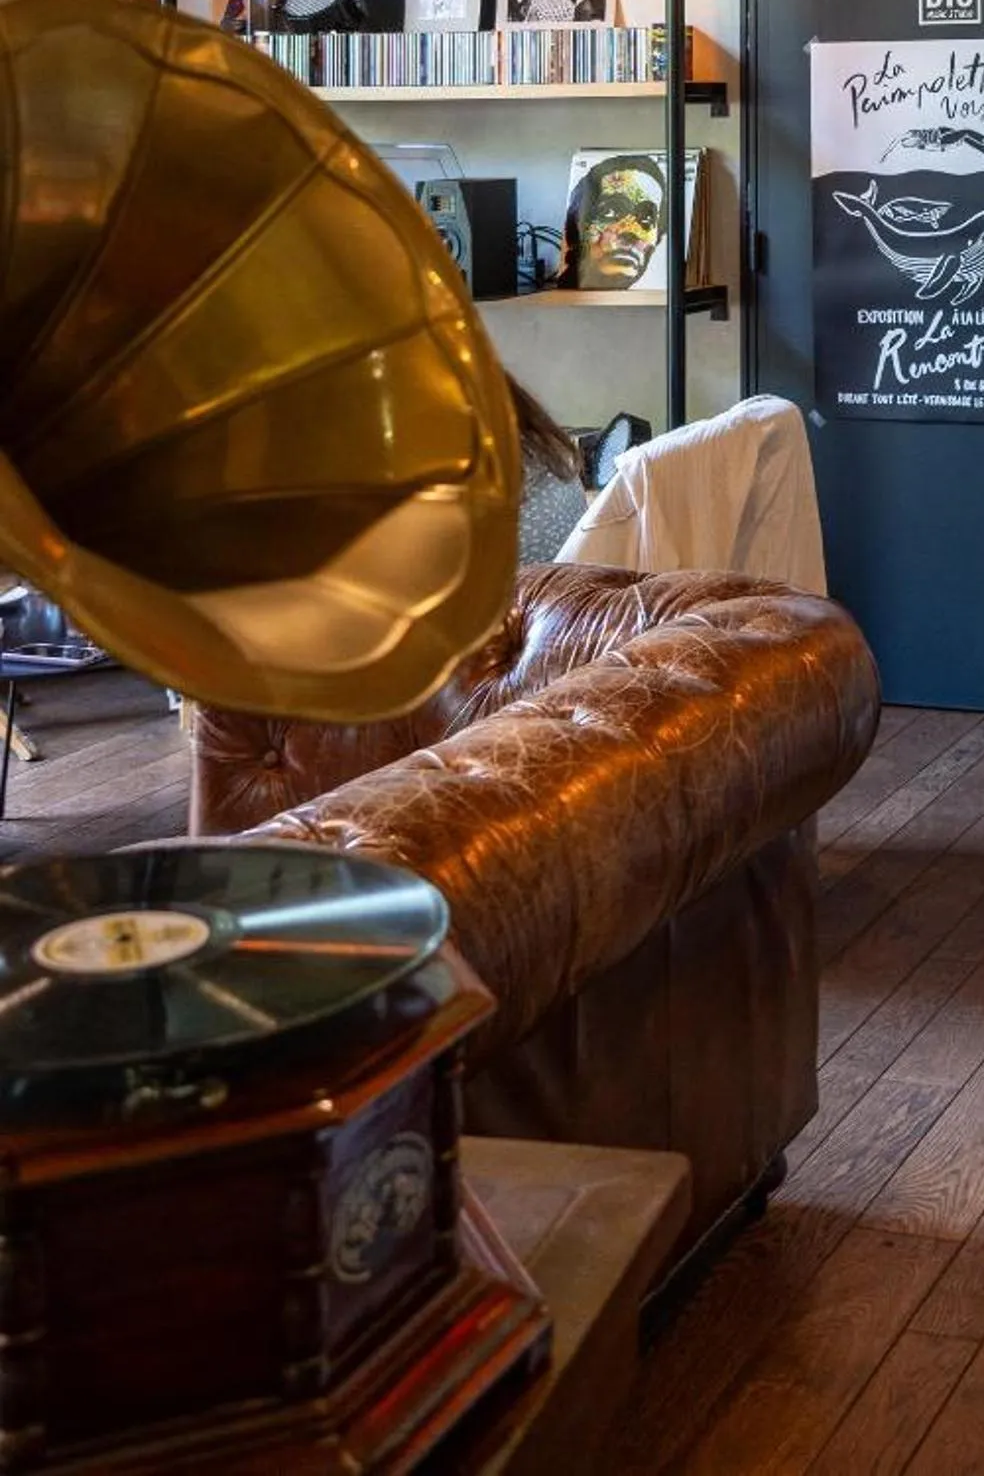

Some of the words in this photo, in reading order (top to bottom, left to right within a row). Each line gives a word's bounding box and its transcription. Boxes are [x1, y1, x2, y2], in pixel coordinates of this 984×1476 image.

[873, 50, 907, 85] La
[857, 310, 924, 324] EXPOSITION
[960, 311, 974, 325] LA
[914, 309, 955, 350] La
[871, 393, 893, 404] TOUT
